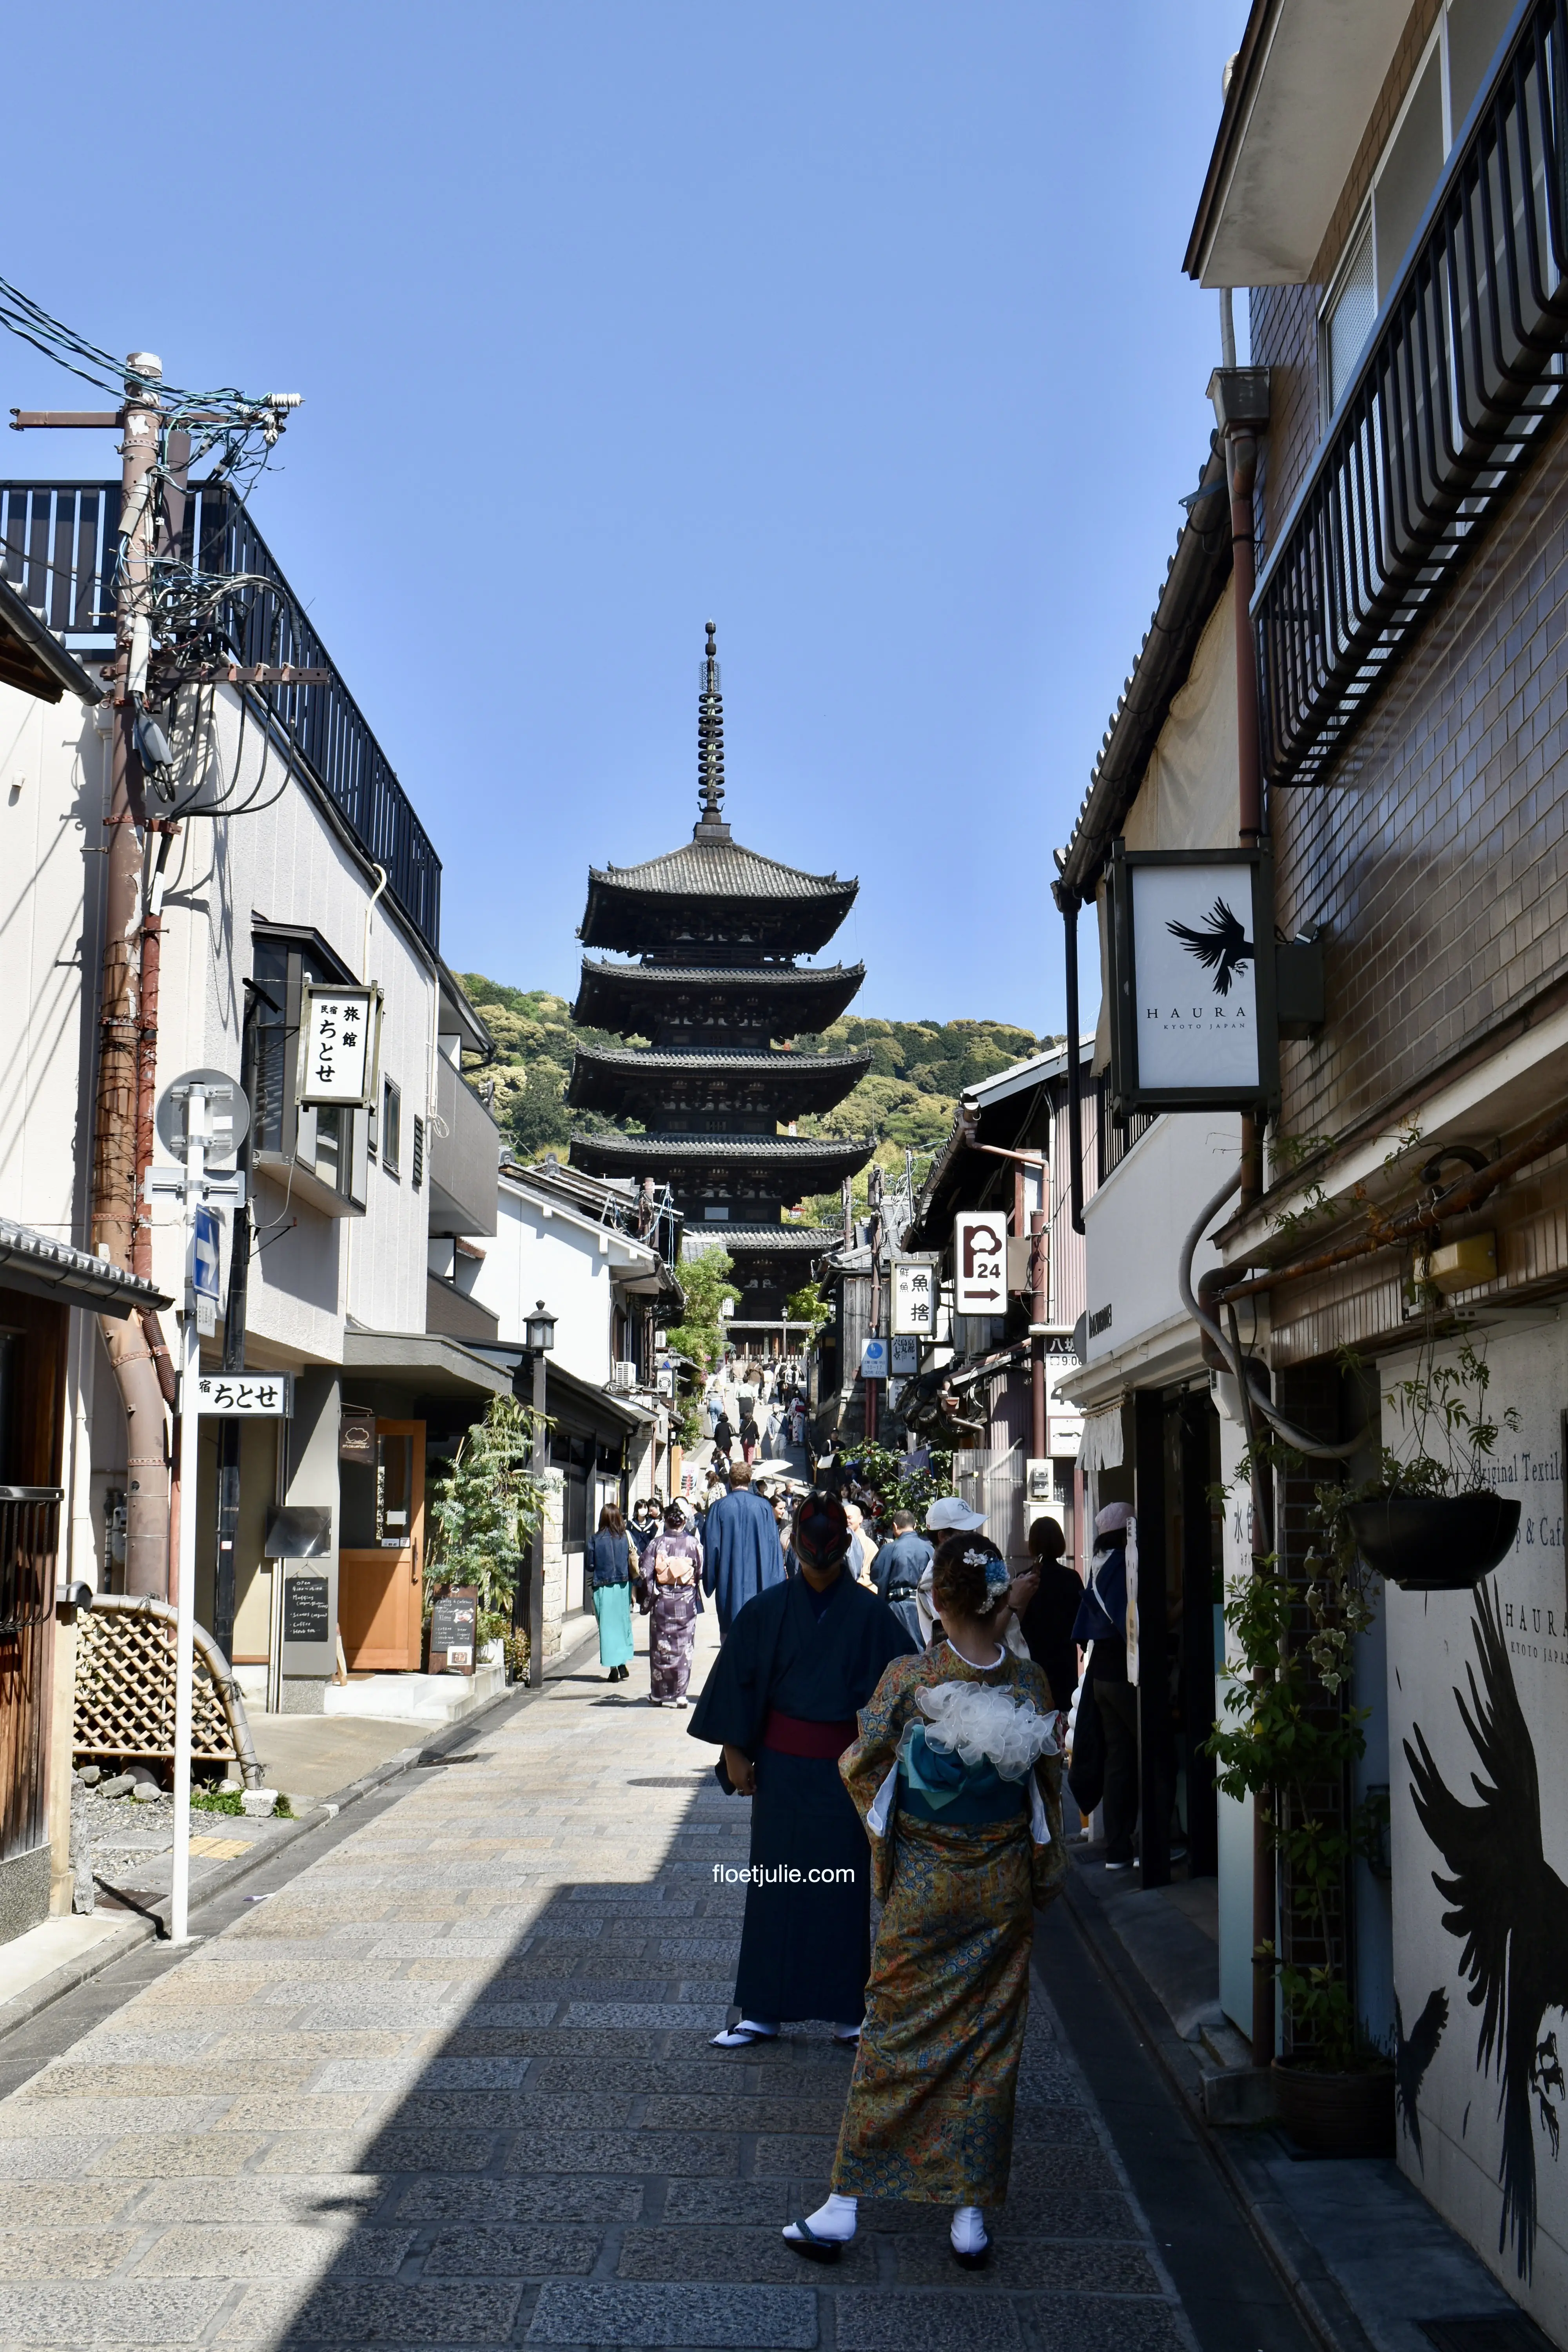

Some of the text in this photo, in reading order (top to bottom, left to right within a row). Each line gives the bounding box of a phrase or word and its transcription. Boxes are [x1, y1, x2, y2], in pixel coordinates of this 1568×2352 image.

[321, 1005, 338, 1014] 民宿
[1147, 1007, 1246, 1018] HAURA
[343, 1006, 360, 1047] 旅館
[315, 1019, 336, 1082] ちとせ
[977, 1263, 1000, 1278] 24
[214, 1384, 278, 1408] ちとせ
[1540, 1516, 1565, 1546] Caf
[1511, 1641, 1537, 1658] KYOTO
